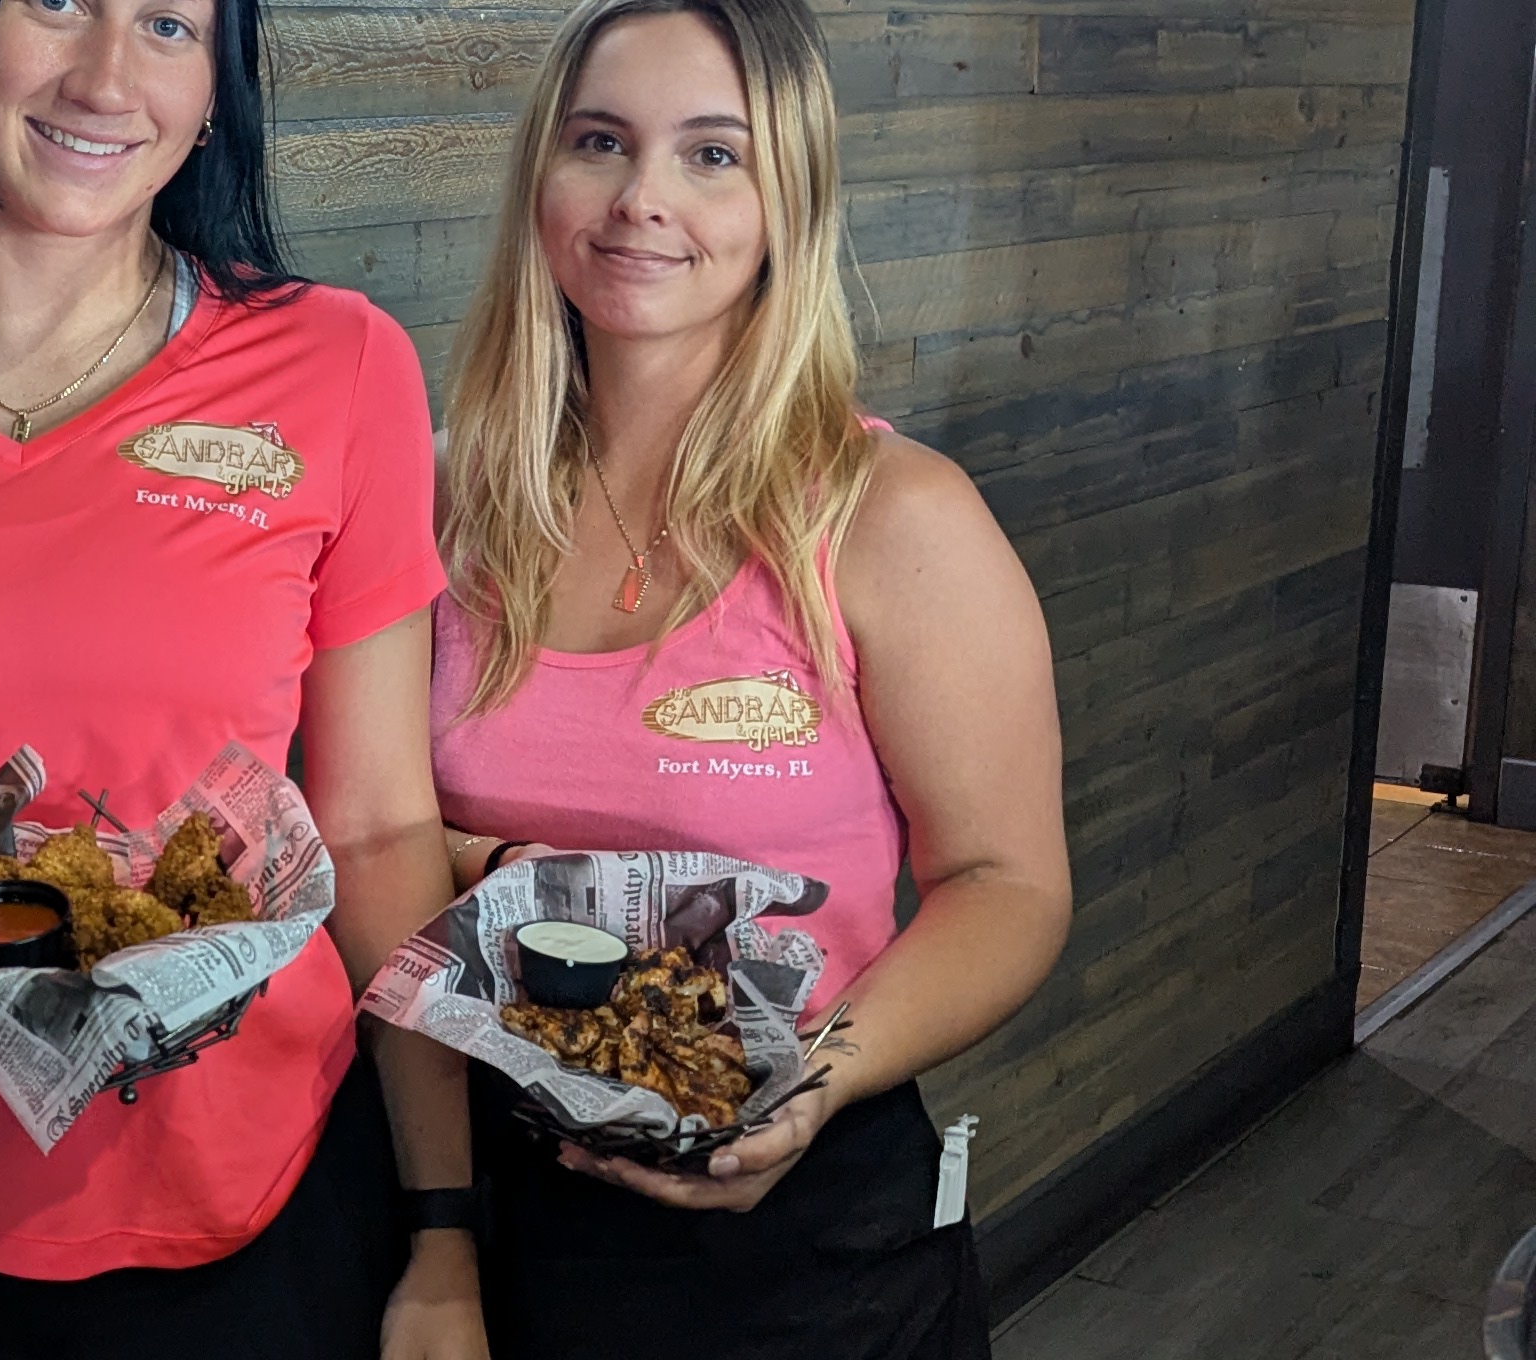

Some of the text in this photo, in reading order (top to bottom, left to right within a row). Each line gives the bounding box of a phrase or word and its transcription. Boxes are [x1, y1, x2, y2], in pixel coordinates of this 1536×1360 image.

[138, 435, 290, 476] SANDBAR
[136, 489, 269, 530] Fort Myers, FL
[659, 695, 807, 727] SANDBAR
[658, 758, 813, 780] Fort Myers, FL
